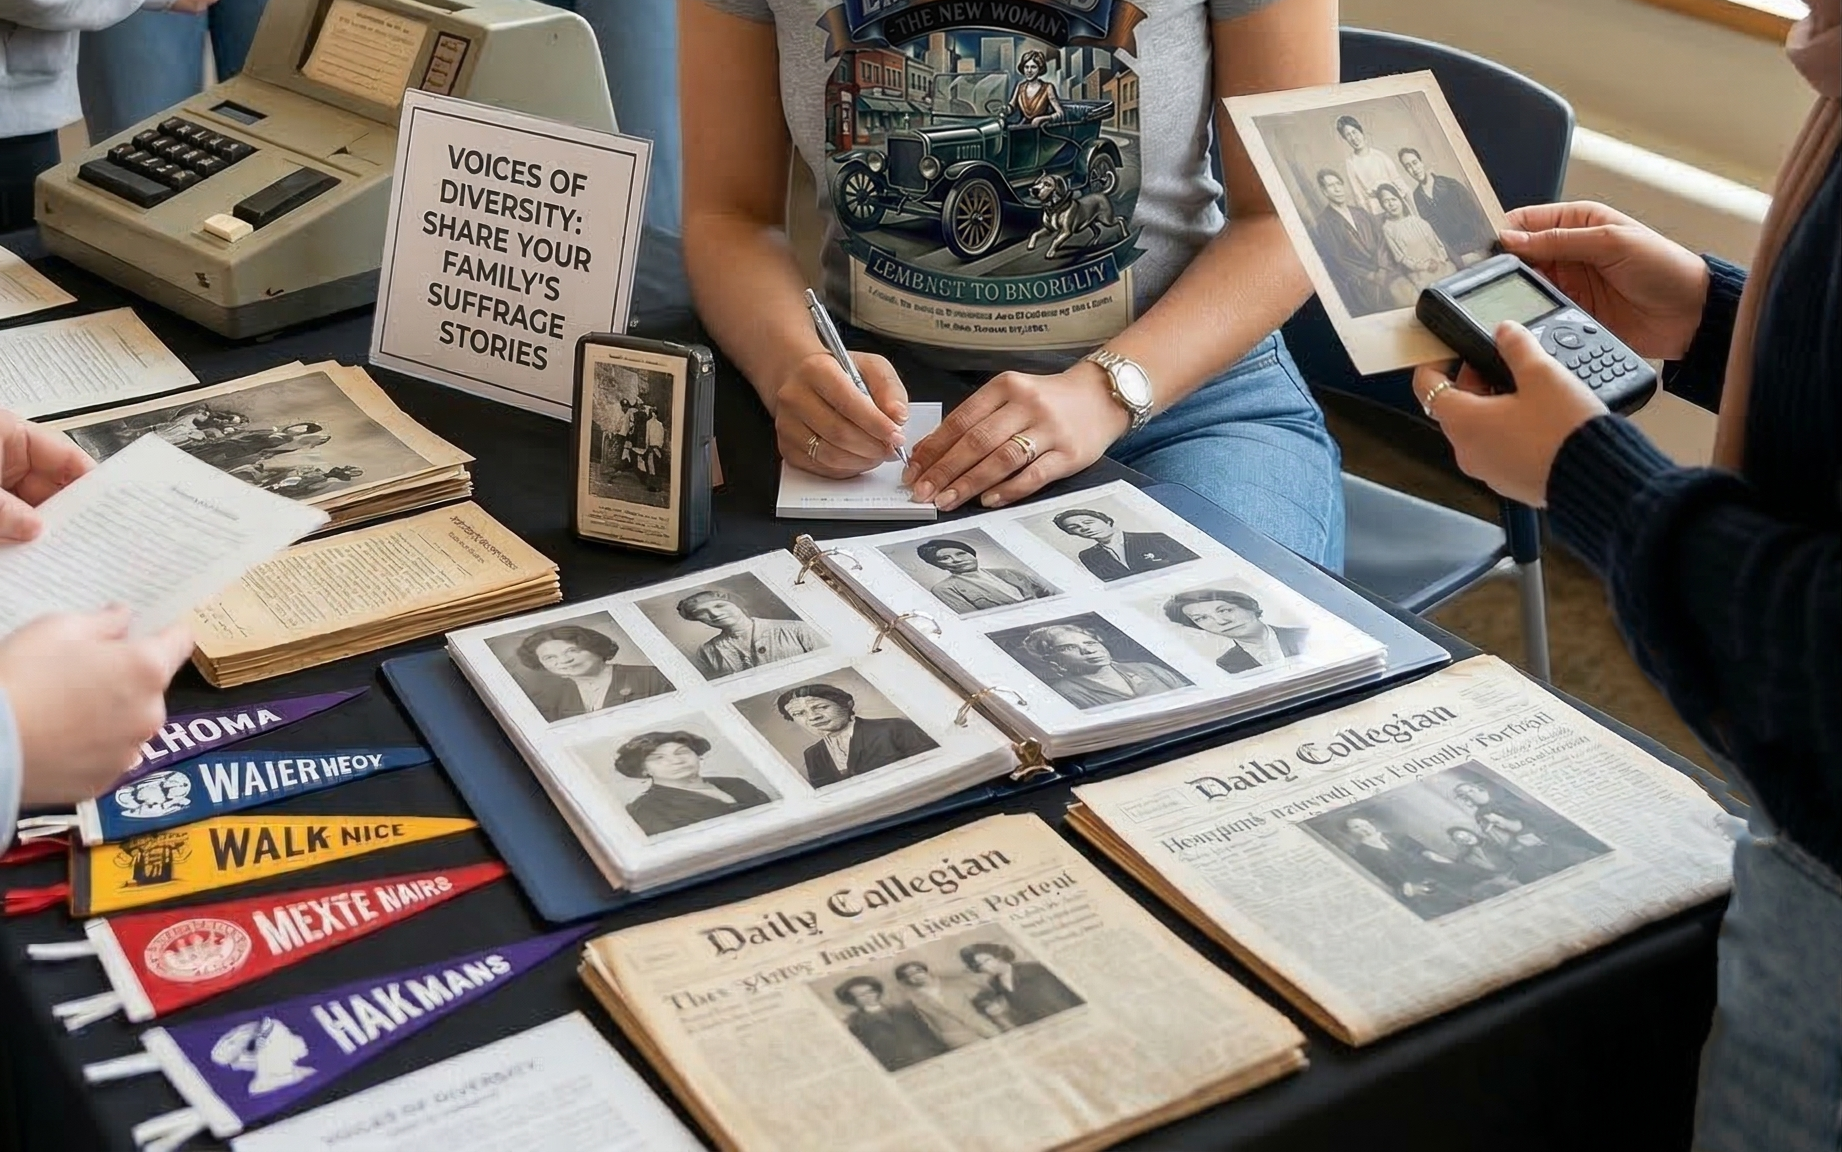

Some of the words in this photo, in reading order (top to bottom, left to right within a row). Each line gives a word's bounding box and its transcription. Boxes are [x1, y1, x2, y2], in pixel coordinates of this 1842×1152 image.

[939, 1, 984, 24] NEW
[448, 144, 542, 189] VOICES
[550, 168, 588, 198] OF
[439, 178, 582, 236] DIVERSITY:
[422, 210, 510, 254] SHARE
[517, 232, 592, 273] YOUR
[442, 249, 561, 302] FAMILY'S
[971, 283, 999, 301] TO
[427, 281, 566, 340] SUFFRAGE
[439, 320, 548, 371] STORIES
[1184, 758, 1299, 801] Daily
[1296, 705, 1458, 765] Collegian
[209, 825, 330, 871] WALK
[341, 823, 406, 846] NICE
[252, 890, 380, 956] MEXTE
[697, 910, 824, 960] Daily
[827, 848, 1012, 918] Collegian
